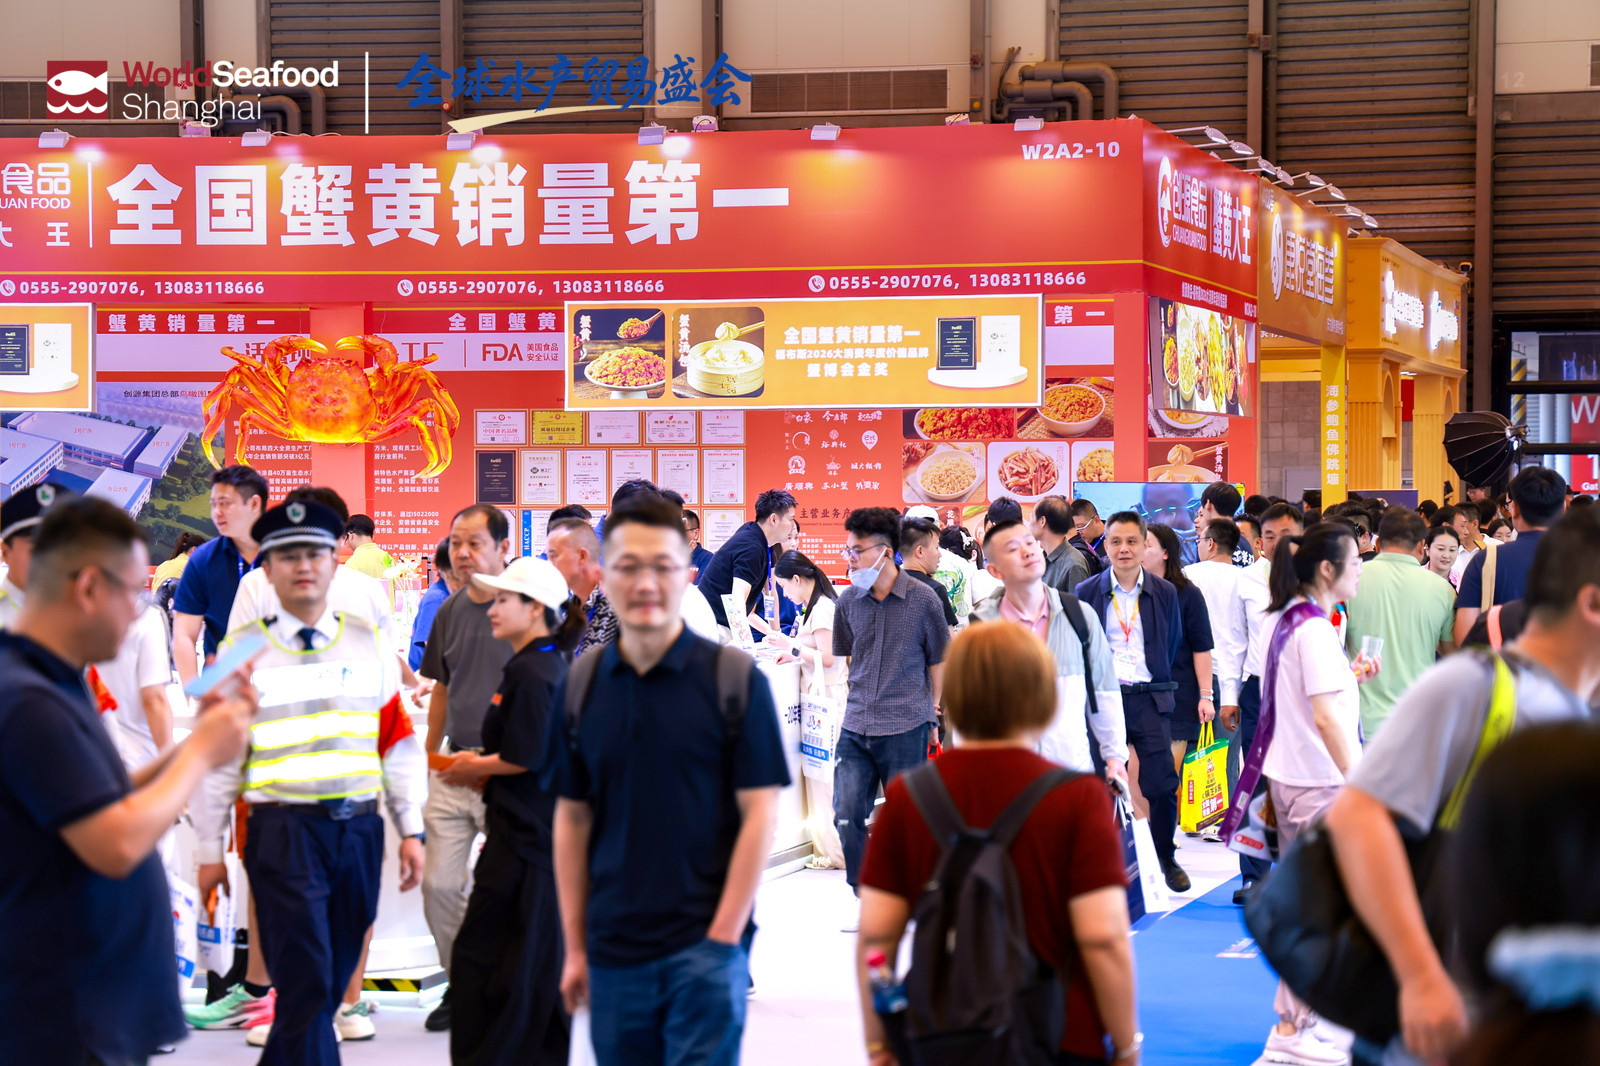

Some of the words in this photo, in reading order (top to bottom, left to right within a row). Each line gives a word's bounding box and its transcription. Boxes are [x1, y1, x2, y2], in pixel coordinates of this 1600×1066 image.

[1502, 71, 1525, 89] 12
[1021, 141, 1120, 160] W2A2-10
[0, 162, 72, 195] 食品
[31, 197, 72, 209] FOOD
[106, 160, 789, 248] 全国蟹黄销量第一
[1212, 186, 1252, 265] 蟹黄大王
[154, 280, 265, 295] 13083118666
[553, 279, 664, 294] 13083118666
[969, 271, 1086, 287] 13083118666
[108, 313, 276, 332] 蟹黄销量第一
[448, 311, 556, 331] 全国蟹黄
[1053, 305, 1105, 325] 第一
[783, 324, 921, 345] 全国蟹黄销量第一
[481, 343, 524, 361] FDA
[526, 342, 559, 352] 美国食品
[526, 352, 559, 362] 安全认证
[1325, 384, 1340, 485] 海参鲍鱼佛跳墙
